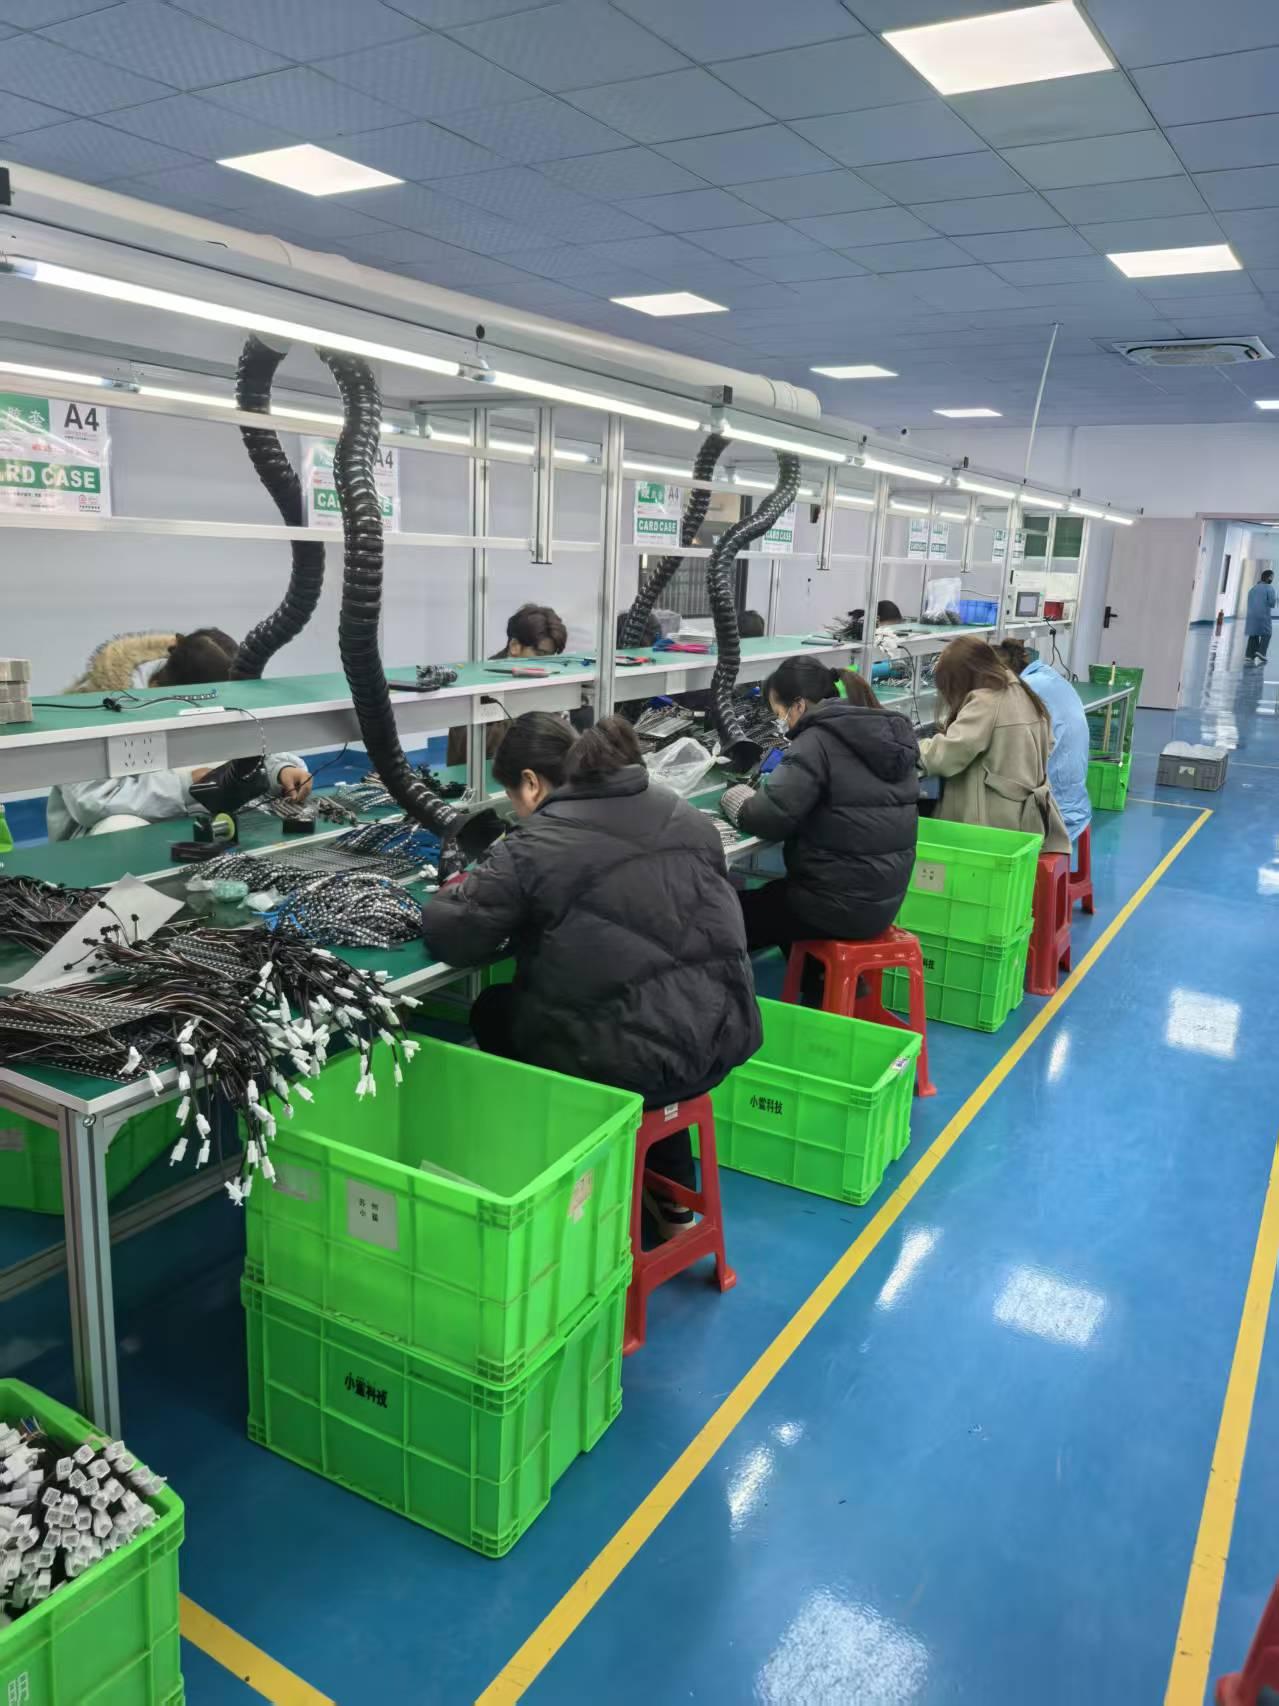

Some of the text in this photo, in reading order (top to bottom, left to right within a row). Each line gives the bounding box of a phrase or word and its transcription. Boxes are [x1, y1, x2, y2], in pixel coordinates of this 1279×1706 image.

[64, 403, 99, 431] A4
[41, 465, 96, 489] CASE
[668, 487, 679, 500] A4
[638, 519, 676, 532] CARD CASE
